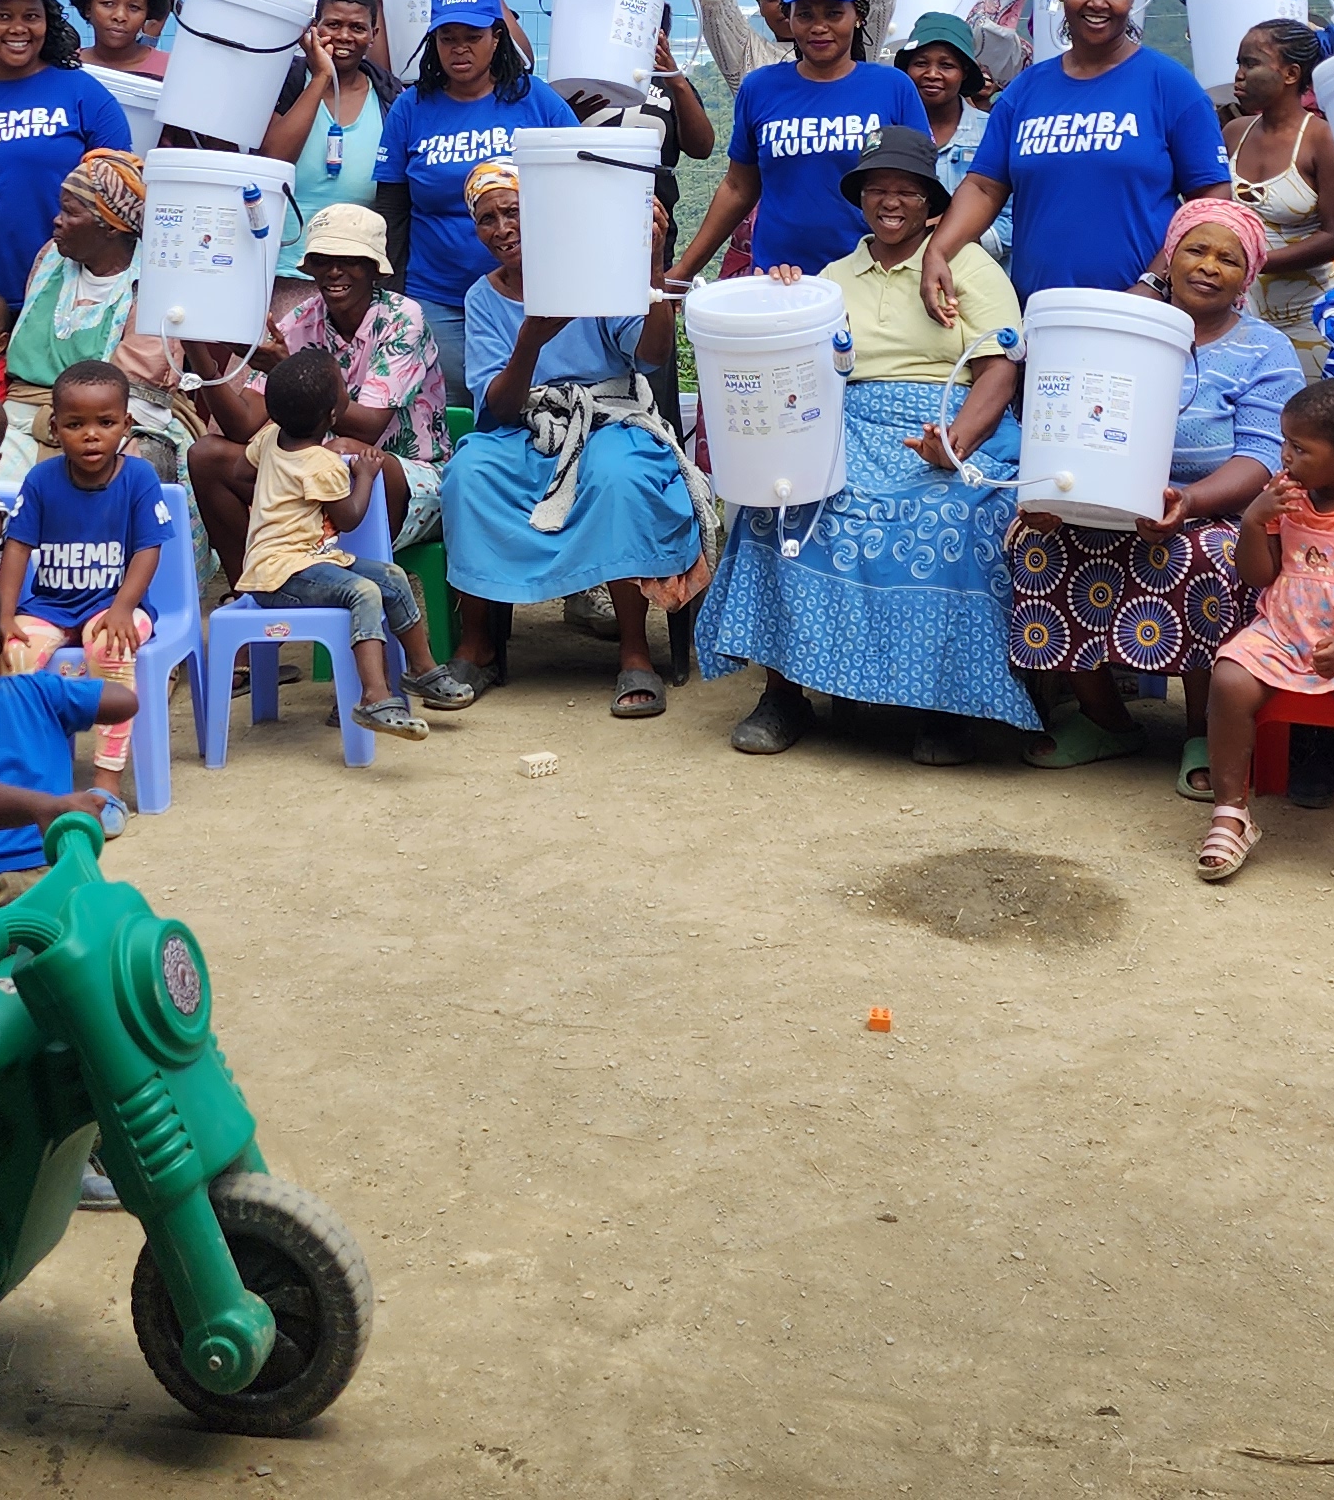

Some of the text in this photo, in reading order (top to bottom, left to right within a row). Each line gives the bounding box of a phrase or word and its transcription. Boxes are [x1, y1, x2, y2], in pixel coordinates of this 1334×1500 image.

[417, 127, 514, 153] ITHEMB
[761, 113, 881, 146] ITHEMBA
[1016, 112, 1139, 145] ITHEMBA
[1020, 133, 1123, 157] KULUNTU
[1037, 383, 1070, 392] AMANZI
[31, 541, 125, 571] ITHEMB
